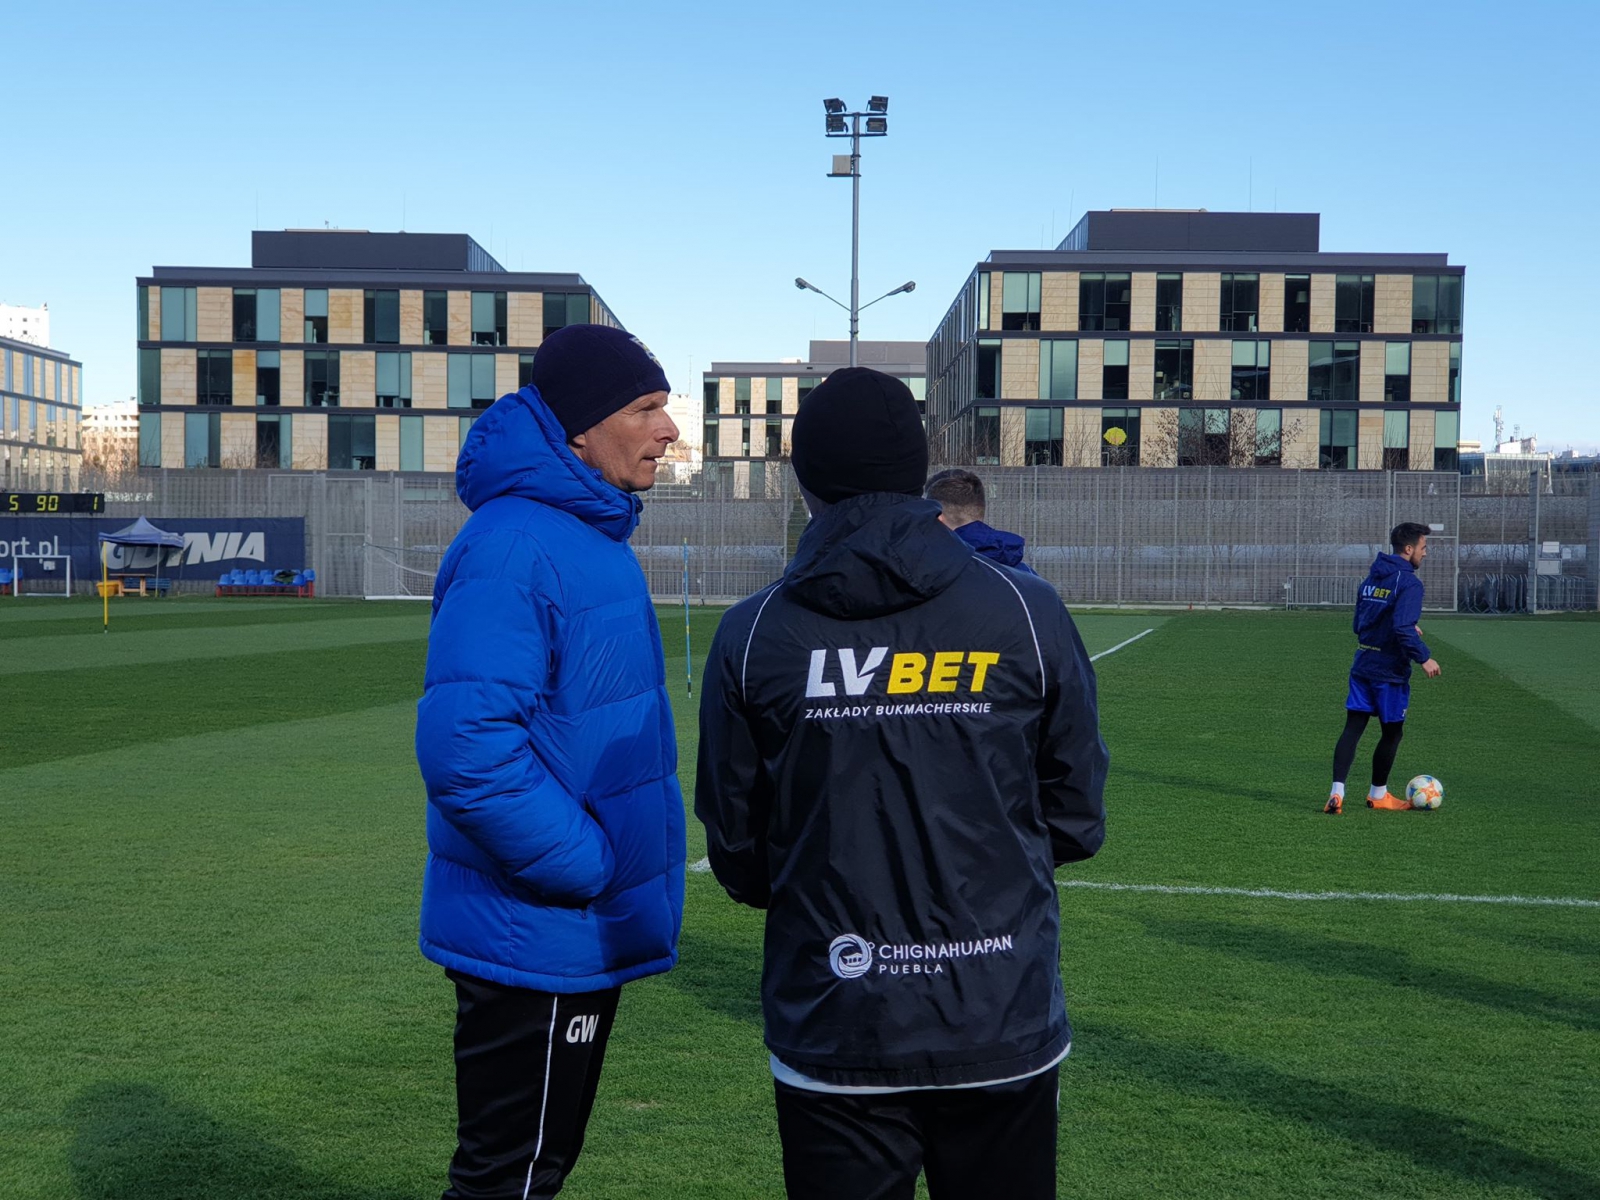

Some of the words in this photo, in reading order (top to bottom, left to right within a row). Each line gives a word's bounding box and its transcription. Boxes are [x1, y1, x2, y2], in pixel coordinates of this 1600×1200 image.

[36, 495, 59, 511] 90
[805, 705, 871, 719] ZAKŁADY
[875, 702, 992, 716] BUKMACHERSKIE
[879, 935, 1013, 960] CHIGNAHUAPAN
[879, 964, 943, 975] PUEBLA
[566, 1014, 599, 1043] GW
